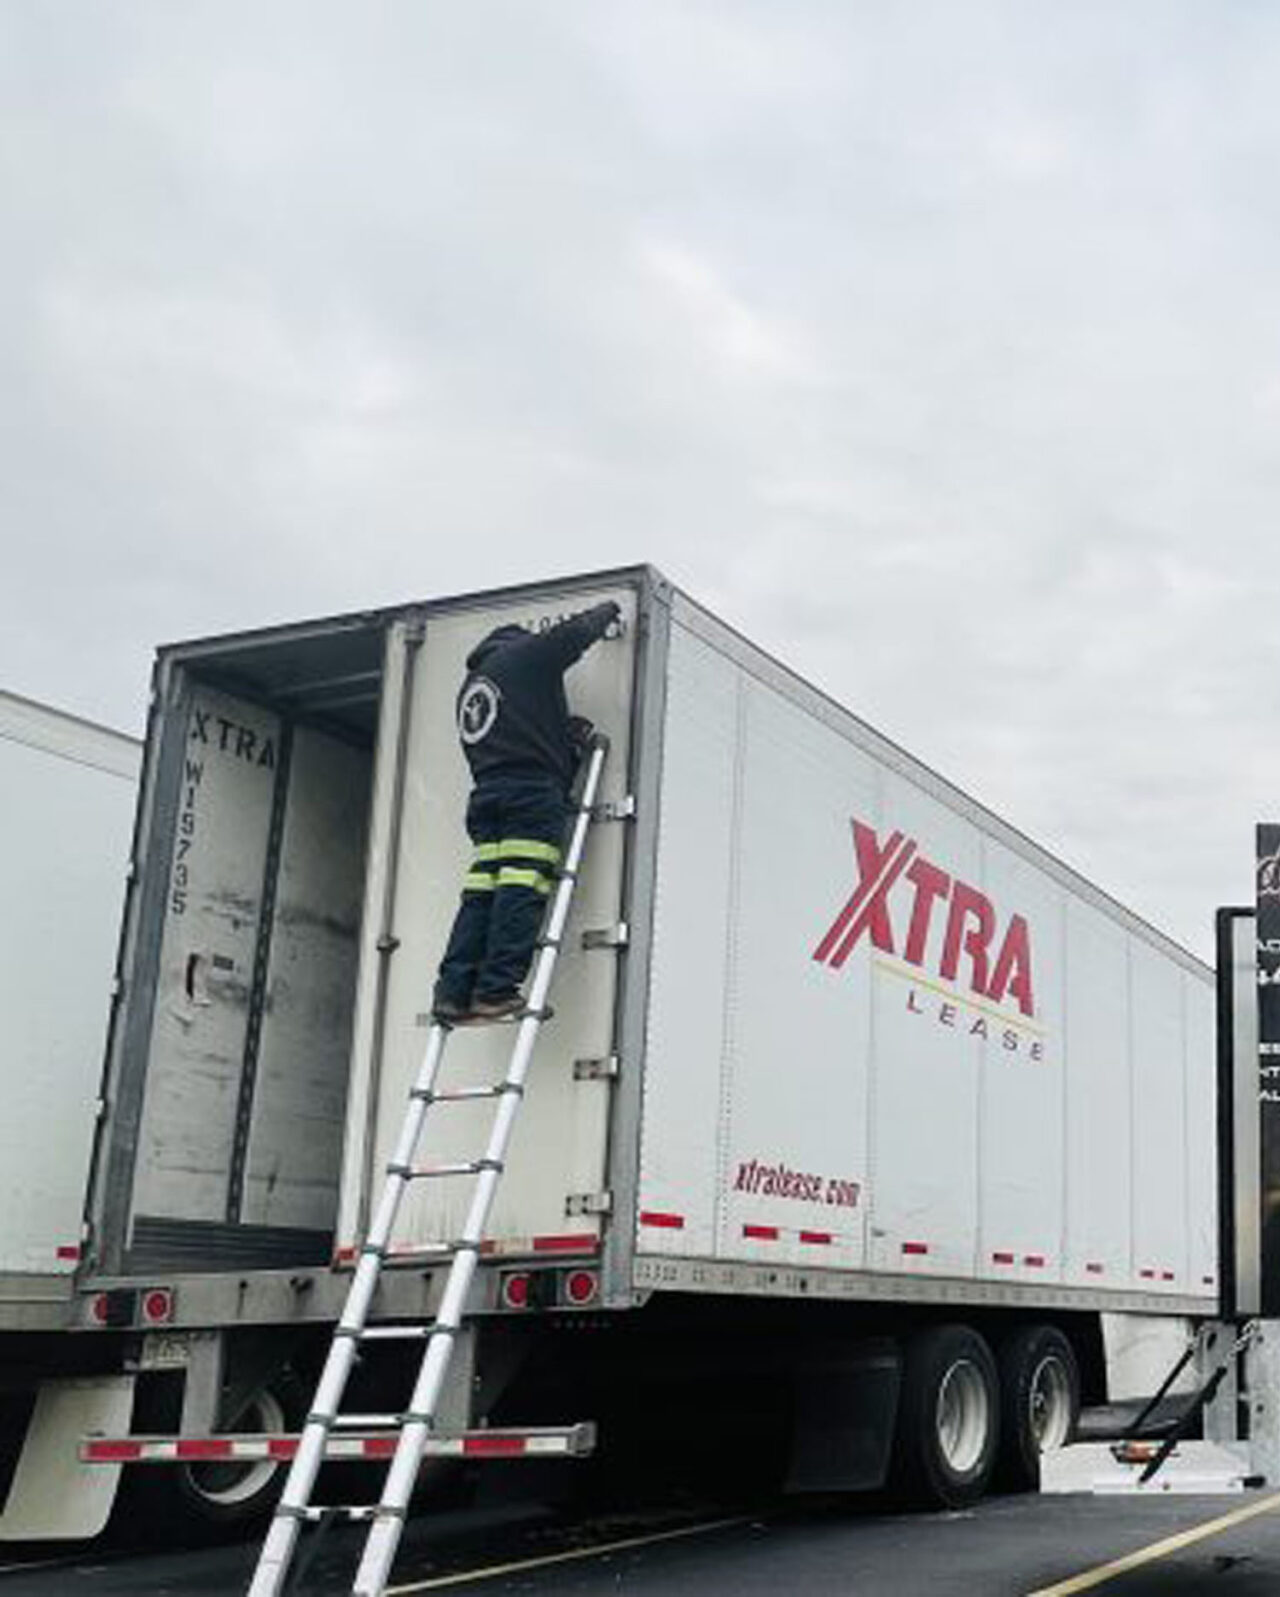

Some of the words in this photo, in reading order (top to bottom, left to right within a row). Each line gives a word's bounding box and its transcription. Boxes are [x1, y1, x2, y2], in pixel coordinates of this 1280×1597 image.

[191, 709, 275, 770] XTRA
[812, 816, 1034, 1017] XTRA
[906, 989, 1044, 1061] LEASE
[733, 1158, 860, 1208] xtralease.com
